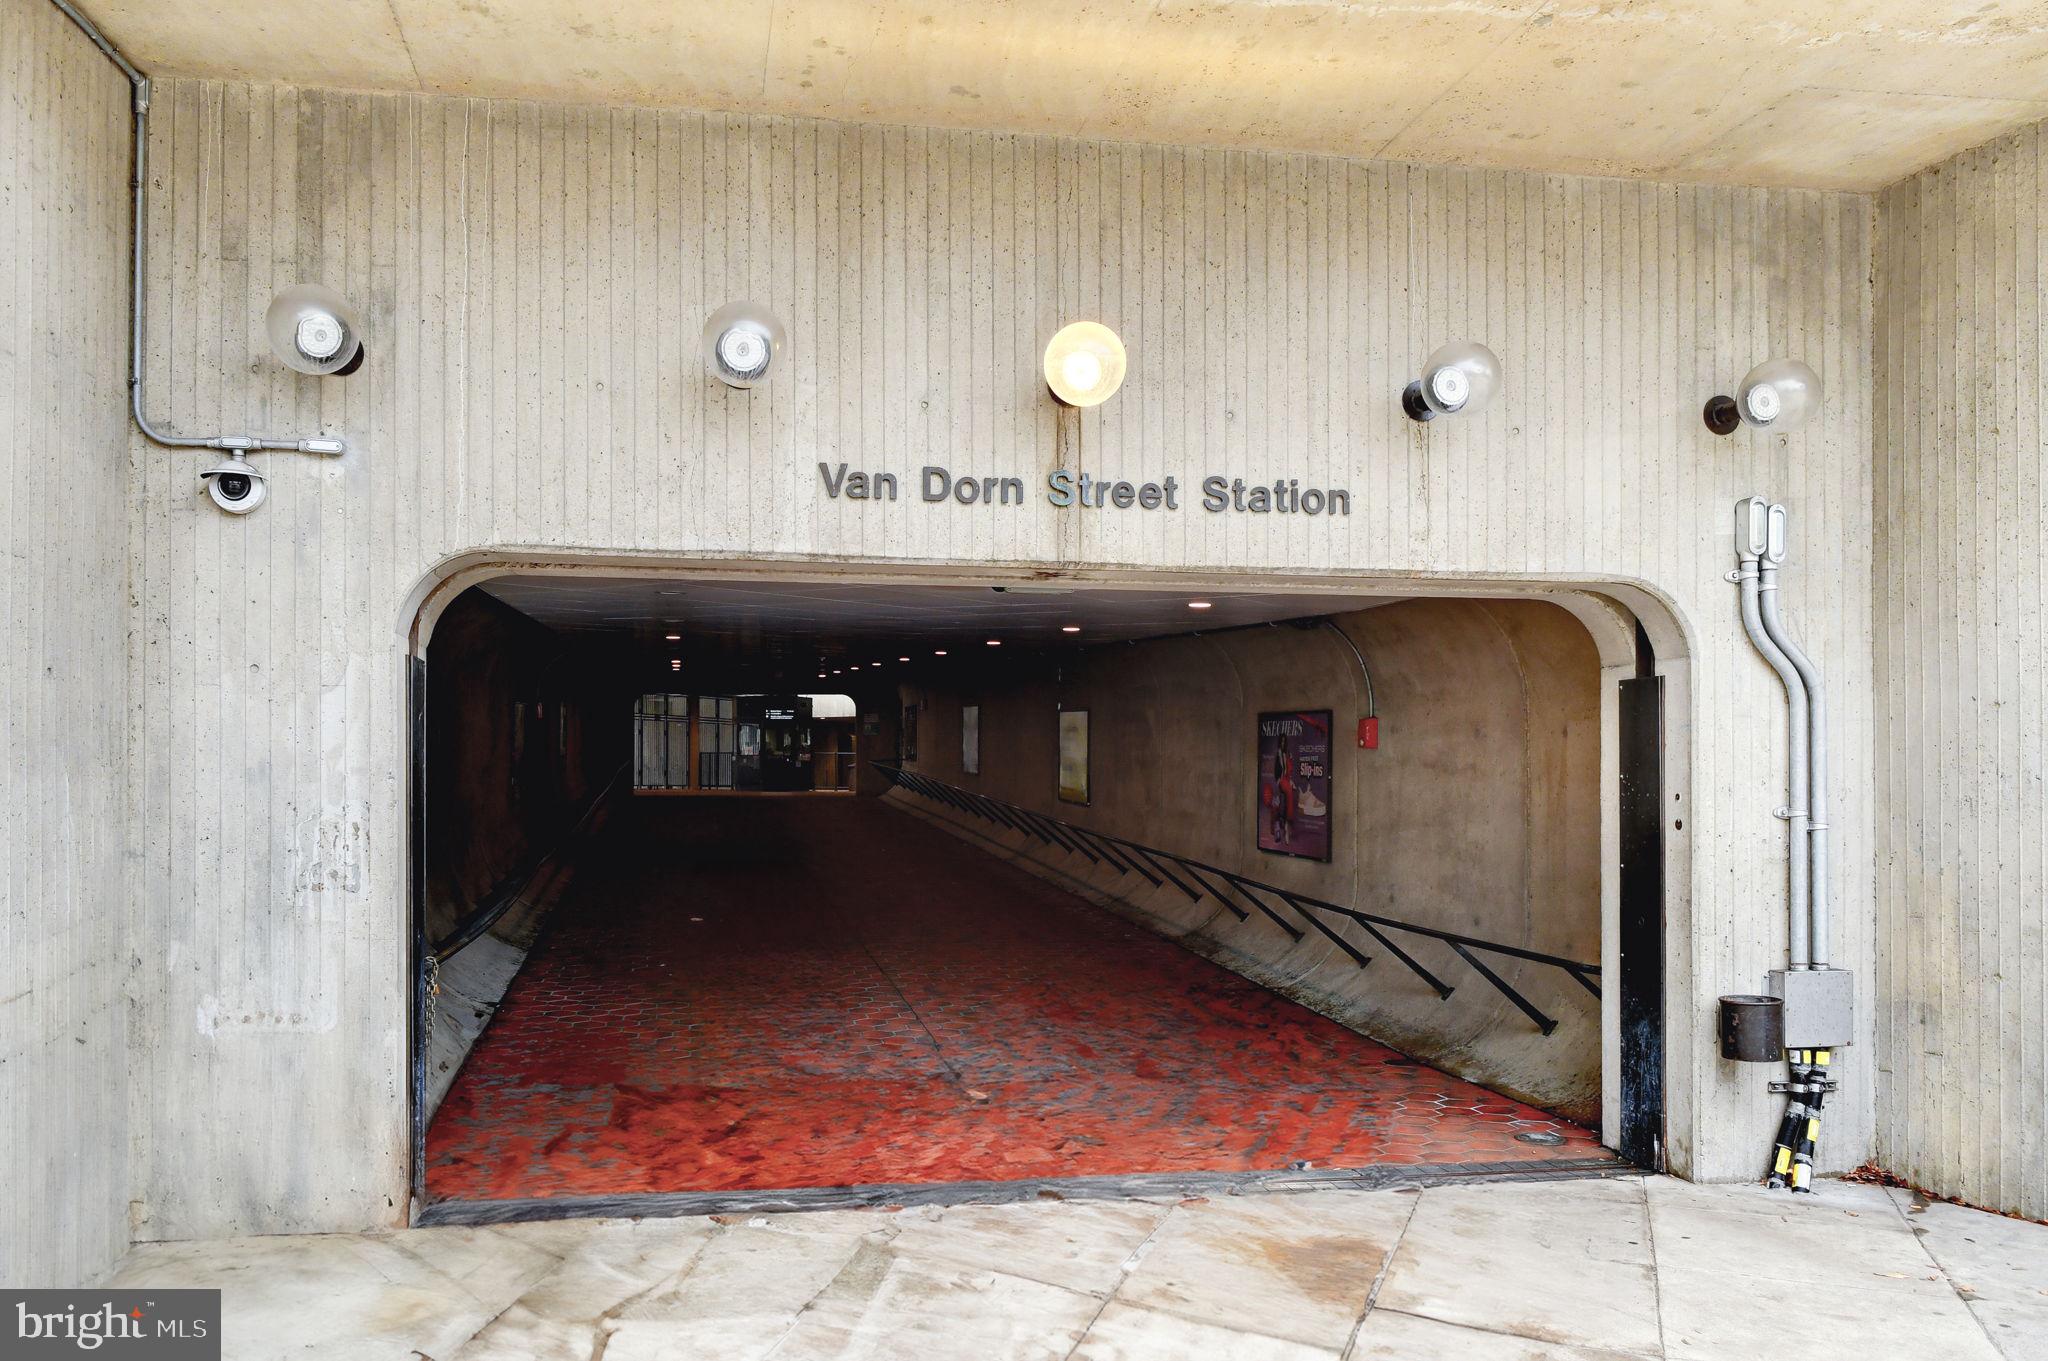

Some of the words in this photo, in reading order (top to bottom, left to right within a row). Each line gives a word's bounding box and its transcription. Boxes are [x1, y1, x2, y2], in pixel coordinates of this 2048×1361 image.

[818, 462, 898, 500] Van
[922, 466, 1024, 504] Dorn
[1048, 469, 1179, 510] Street
[1202, 475, 1350, 515] Station
[1261, 720, 1304, 737] SKECHERS
[1300, 762, 1324, 779] Slip-ins
